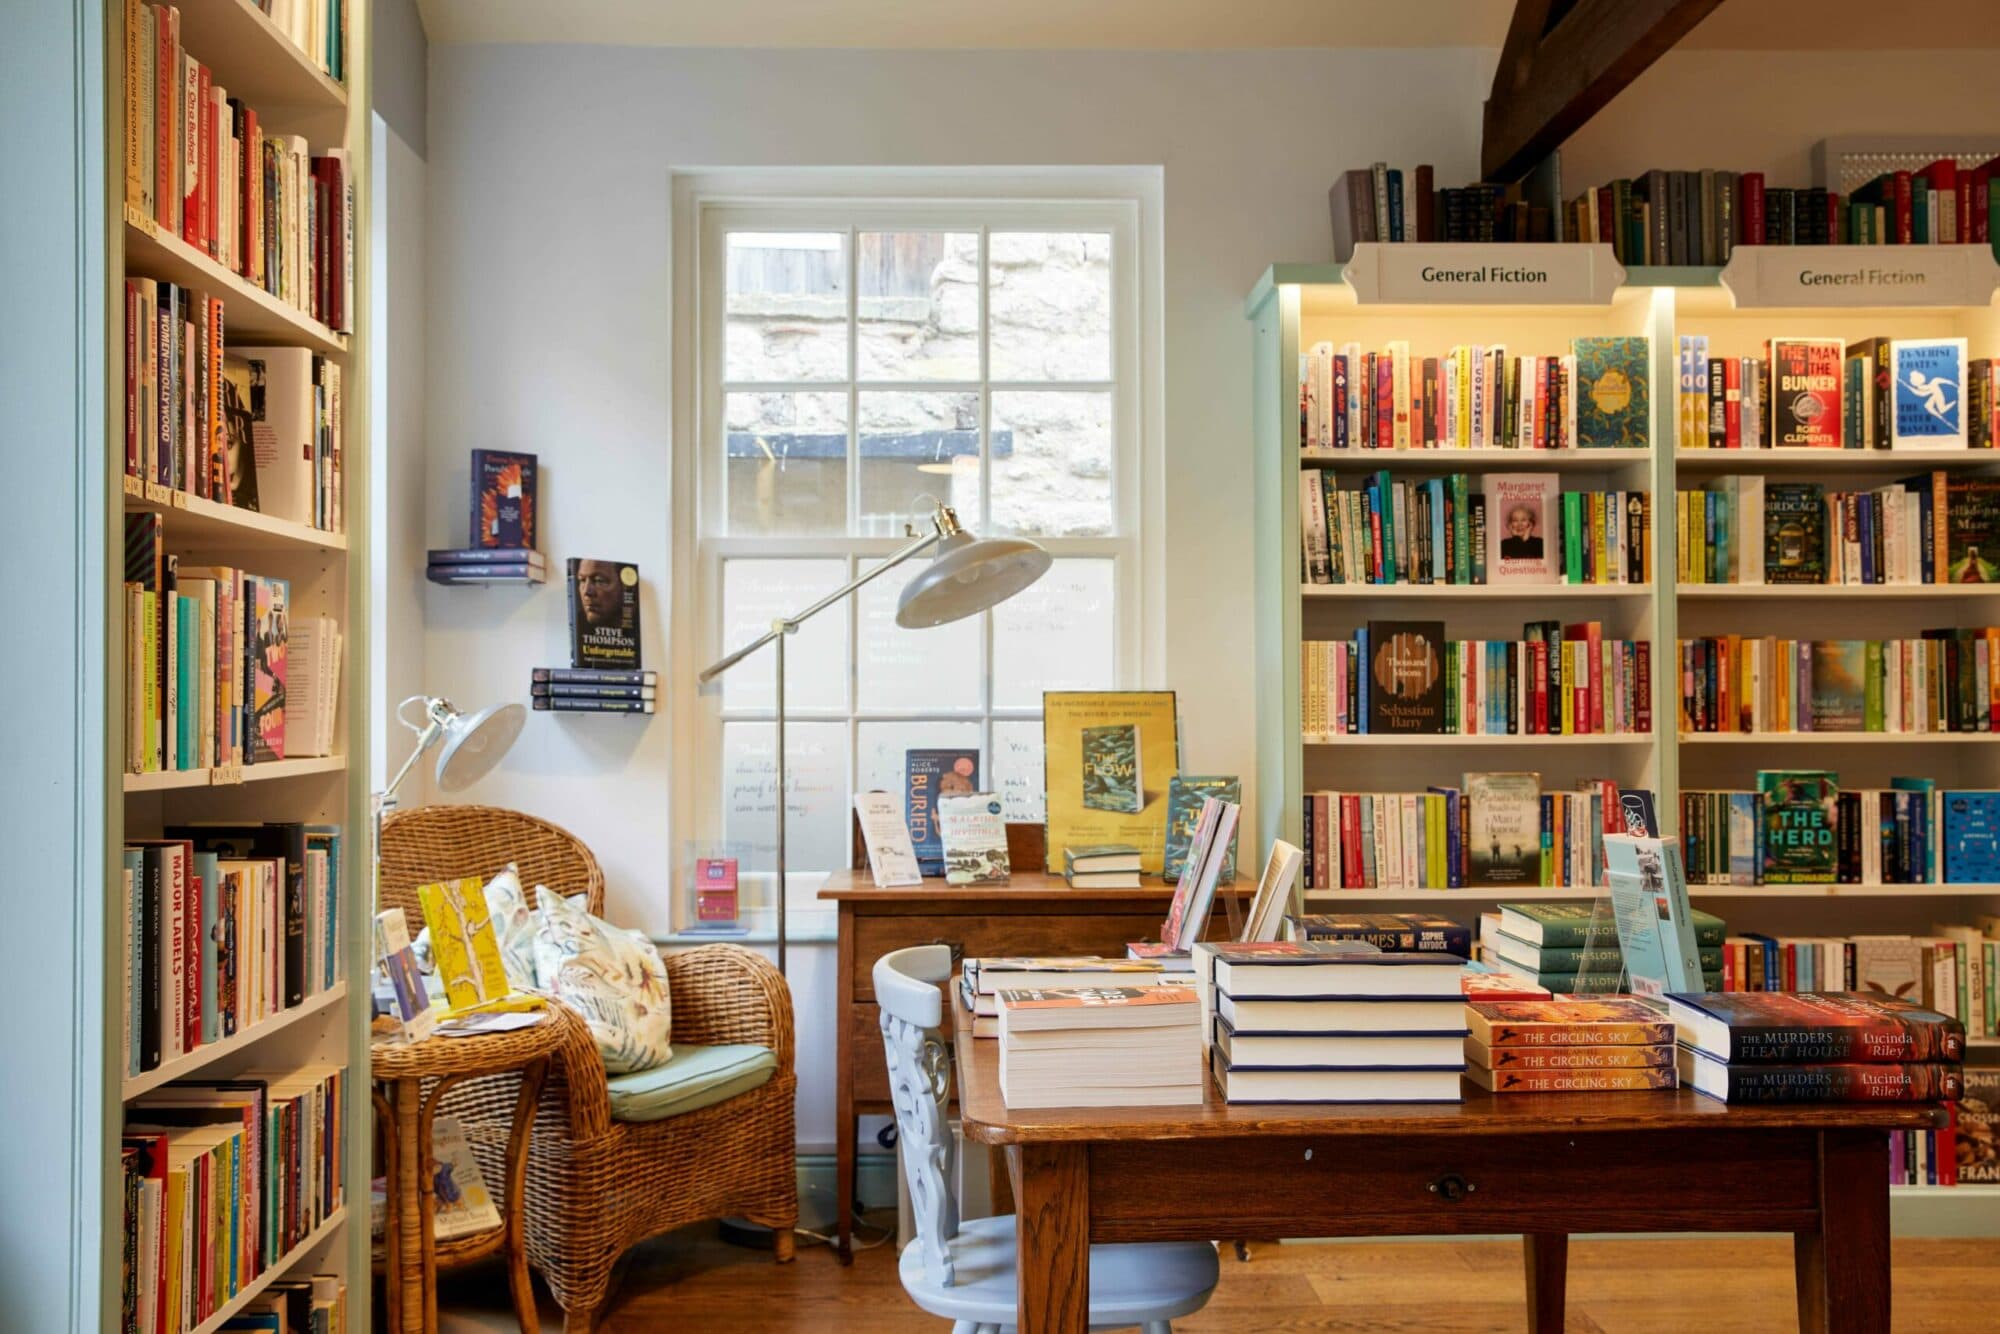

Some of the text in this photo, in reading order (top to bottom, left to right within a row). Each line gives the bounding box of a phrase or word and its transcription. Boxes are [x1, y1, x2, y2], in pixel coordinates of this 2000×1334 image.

[130, 31, 138, 73] RECIPES
[188, 119, 197, 166] Budget
[1422, 266, 1547, 283] General Fiction
[1800, 269, 1925, 287] General Fiction
[160, 314, 171, 358] WOMEN
[1779, 345, 1840, 361] THE MAN
[1790, 361, 1832, 375] IN THE
[1781, 375, 1837, 391] BUNKER
[161, 367, 171, 442] HOLLYWOOD
[1796, 425, 1822, 434] RORY
[1784, 433, 1833, 443] CLEMENTS
[1497, 482, 1545, 493] Margaret
[1596, 502, 1604, 554] TALL BONES
[1499, 566, 1547, 576] Questions
[595, 627, 623, 637] STEVE
[583, 635, 635, 646] THOMPSON
[583, 646, 636, 659] Unforgettable
[1550, 630, 1560, 686] NORTHERN SPY
[1386, 657, 1428, 667] Thousand
[1639, 652, 1648, 707] GUEST BOOK
[1379, 703, 1434, 717] Sebastian
[1391, 717, 1422, 729] Barry
[1094, 753, 1118, 763] THE
[1083, 763, 1134, 778] FLOW
[910, 775, 928, 843] BURIED
[1778, 811, 1823, 828] THE
[1769, 829, 1833, 846] HERD
[172, 855, 182, 976] MAJOR LABELS
[1421, 931, 1444, 941] SOPHIE
[1573, 927, 1589, 935] THE
[1418, 941, 1447, 951] HAYDOCK
[1570, 952, 1619, 961] THE SLOTH
[1570, 977, 1620, 986] THE SLOTH
[1523, 1032, 1630, 1044] THE CIRCLING SKY
[1741, 1035, 1761, 1044] THE
[1764, 1032, 1833, 1044] MURDERS
[1864, 1032, 1914, 1044] Lucinda
[1741, 1045, 1850, 1058] FLEAT HOUSE
[1872, 1046, 1905, 1059] Riley
[1523, 1055, 1630, 1066] THE CIRCLING SKY
[1528, 1078, 1635, 1089] THE CIRCLING SKY
[1740, 1077, 1759, 1085] THE
[1762, 1073, 1832, 1086] MURDERS
[1862, 1073, 1912, 1085] Lucinda
[1870, 1087, 1904, 1100] Riley
[1958, 1166, 2000, 1182] FRAN
